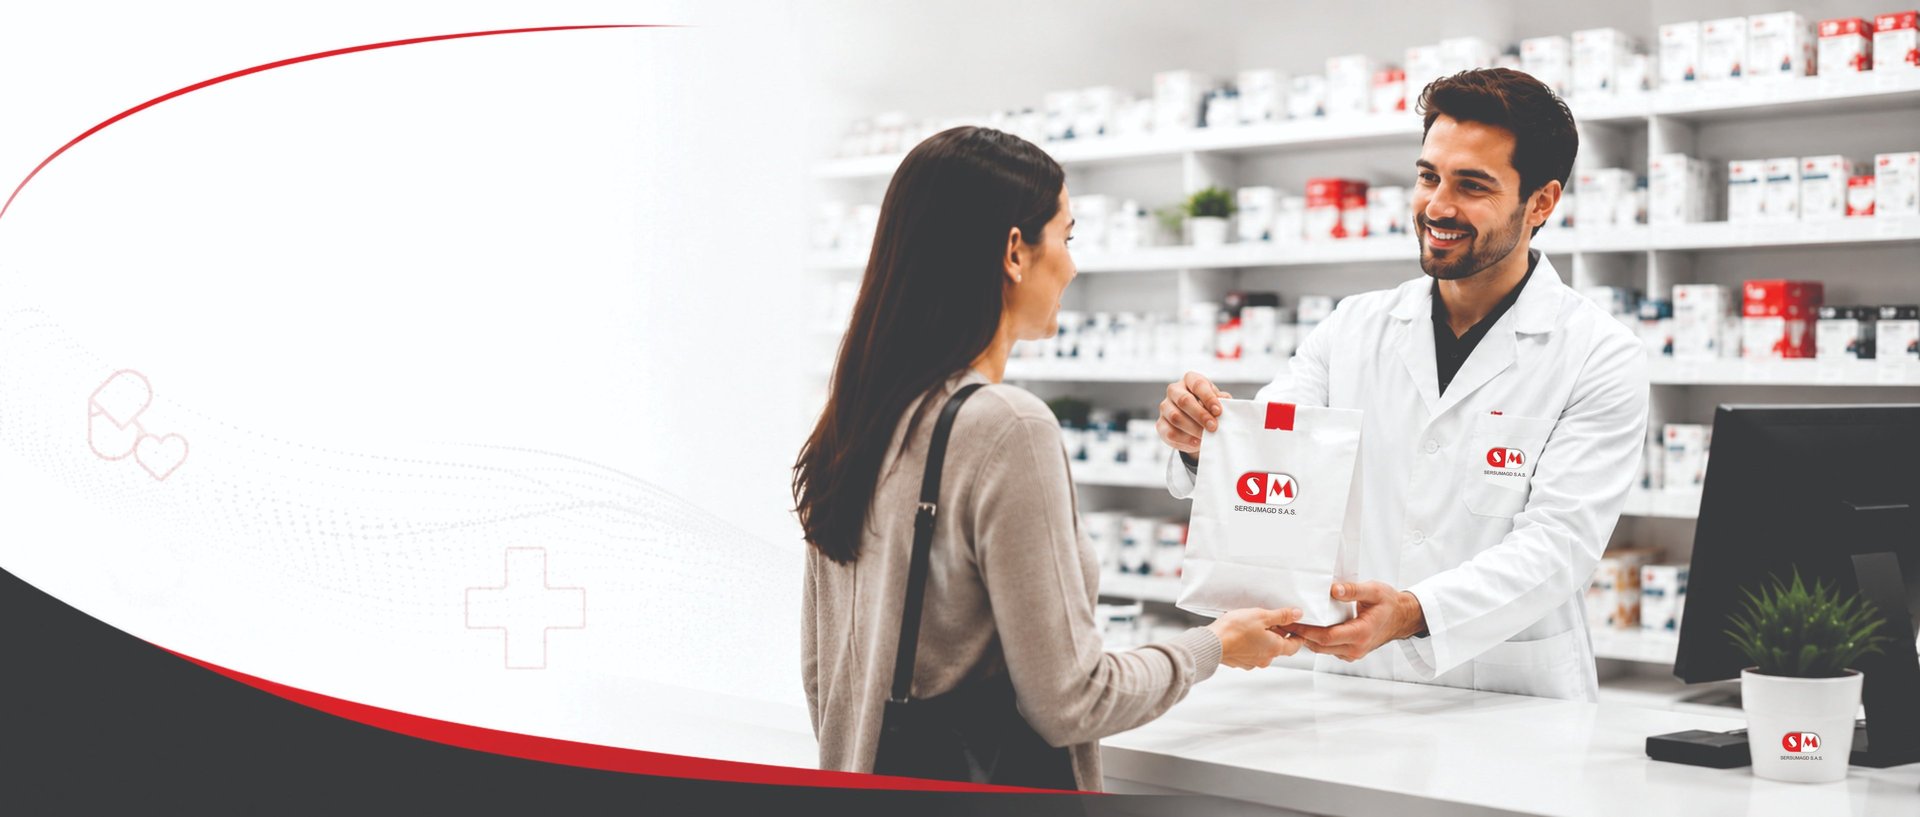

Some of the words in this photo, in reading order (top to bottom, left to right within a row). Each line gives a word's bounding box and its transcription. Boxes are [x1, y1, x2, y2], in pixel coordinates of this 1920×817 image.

[1492, 451, 1522, 464] SM
[1245, 477, 1293, 498] SM
[1234, 505, 1276, 514] SERSUMAGD
[1278, 507, 1296, 515] S.A.S.
[1788, 736, 1818, 748] SM
